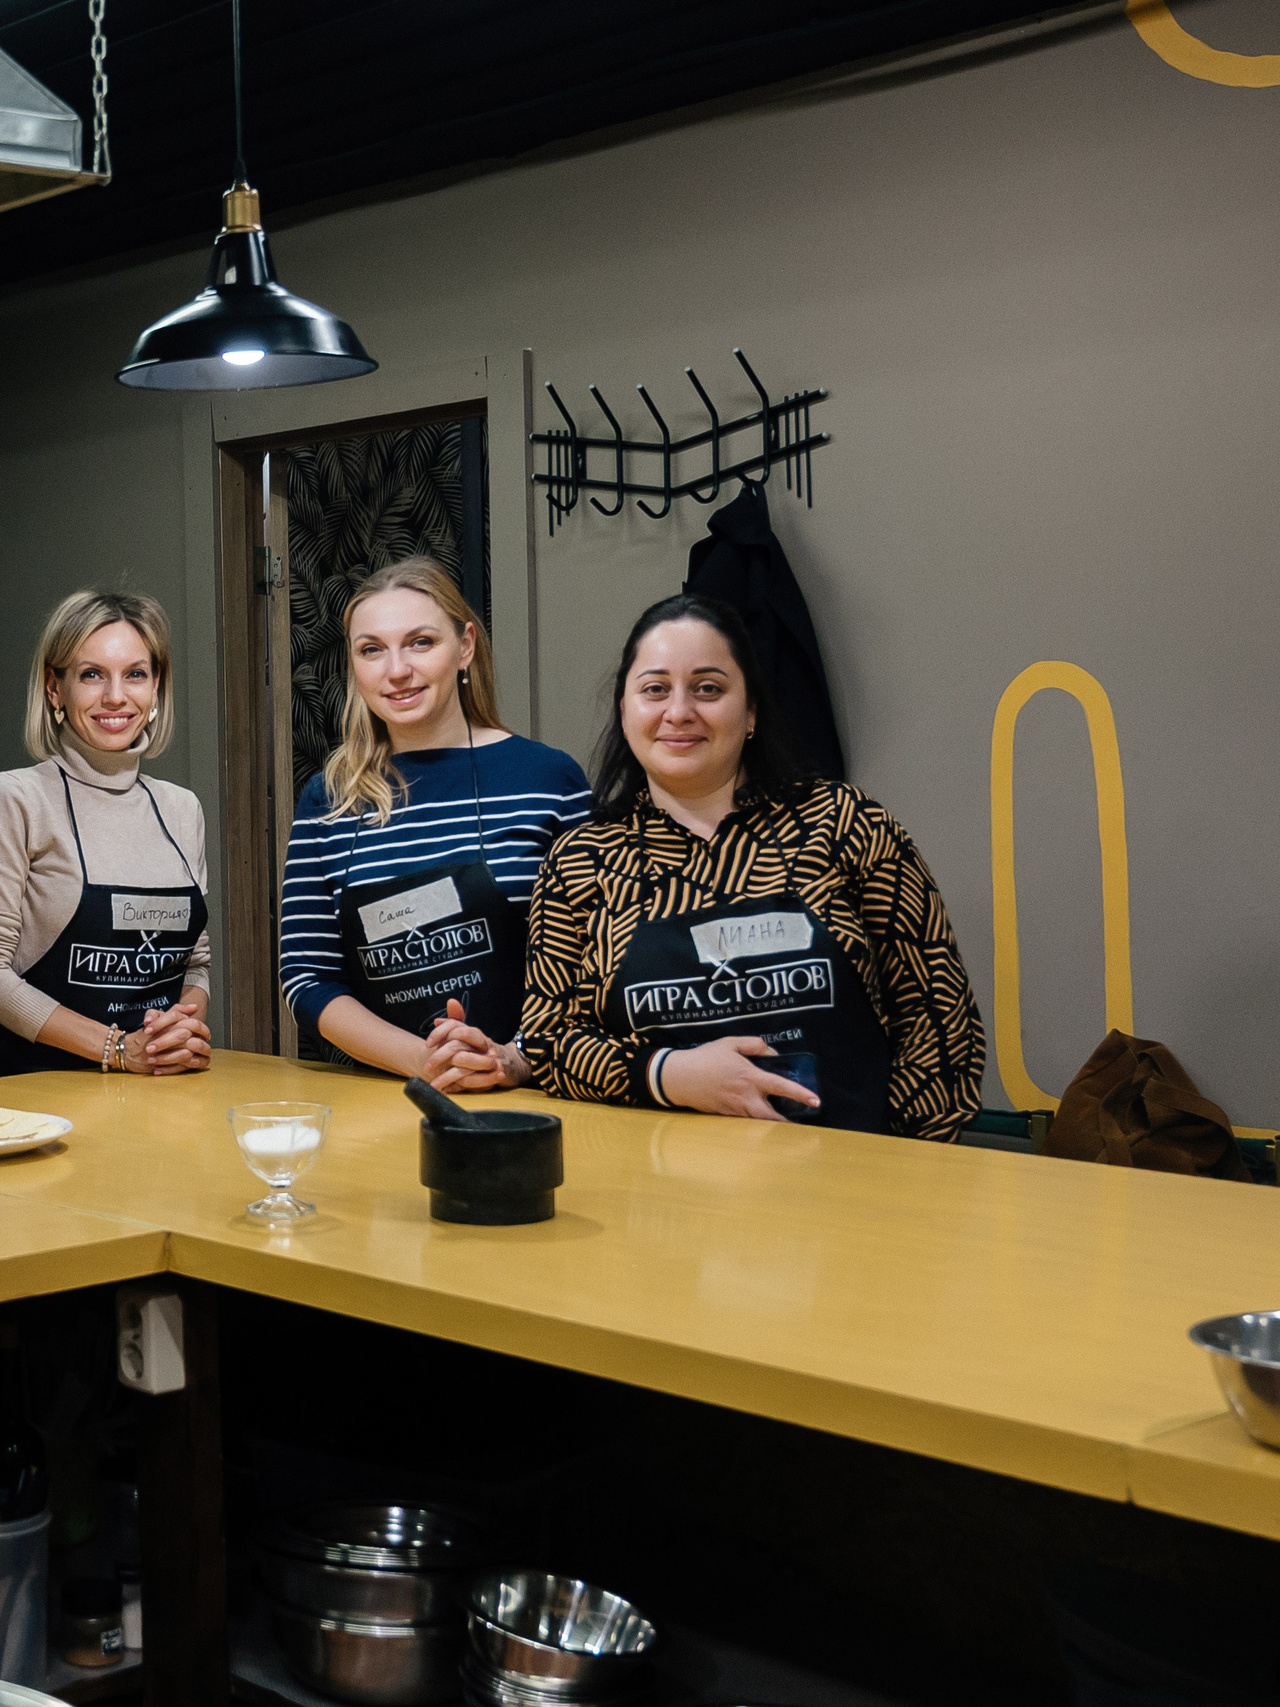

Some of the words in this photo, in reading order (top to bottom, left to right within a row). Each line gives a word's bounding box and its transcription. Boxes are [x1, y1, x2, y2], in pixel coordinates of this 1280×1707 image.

[122, 901, 182, 926] Виктория
[378, 905, 416, 924] Саша
[360, 946, 404, 968] ИГРА
[404, 924, 485, 960] СТОЛОВ
[75, 950, 131, 974] ИГРА
[95, 975, 150, 983] КУЛИНАРНА
[384, 984, 433, 1005] АНОХИН
[434, 969, 482, 995] СЕРГЕЙ
[631, 985, 703, 1014] ИГРА
[707, 964, 827, 1006] СТОЛОВ
[661, 1005, 741, 1022] КУЛИНАРНАЯ
[746, 996, 795, 1012] СТУДИЯ
[759, 1026, 803, 1044] ЛЕКСЕЙ
